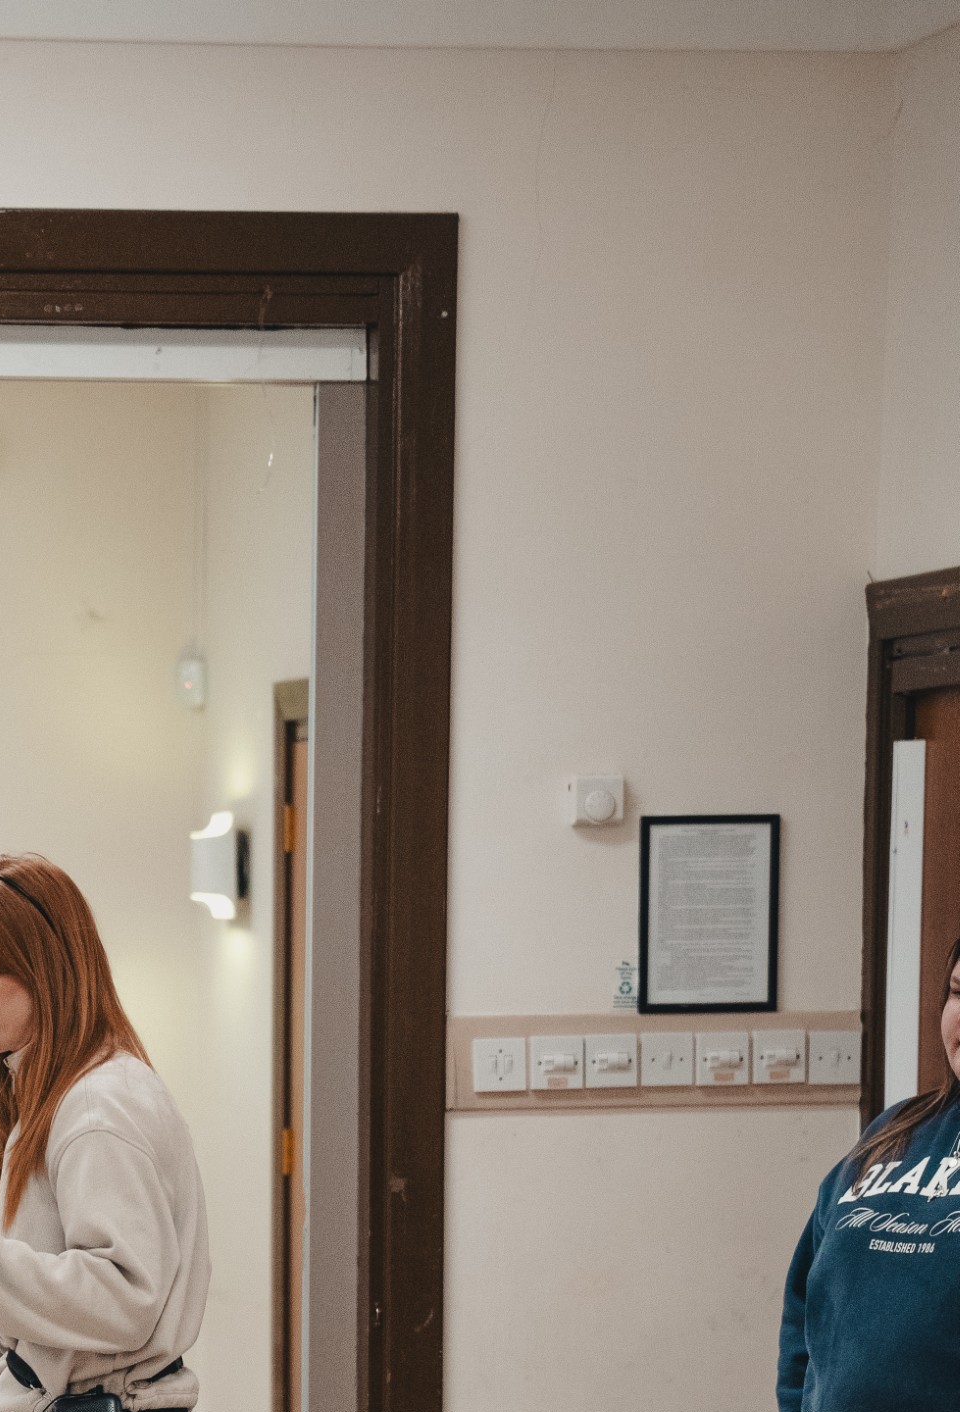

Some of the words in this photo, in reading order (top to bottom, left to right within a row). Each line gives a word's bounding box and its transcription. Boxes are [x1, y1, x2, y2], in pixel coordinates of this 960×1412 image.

[837, 1156, 960, 1205] BLAK
[835, 1207, 880, 1230] All
[869, 1212, 929, 1235] Season
[868, 1238, 917, 1254] ESTABLISHED
